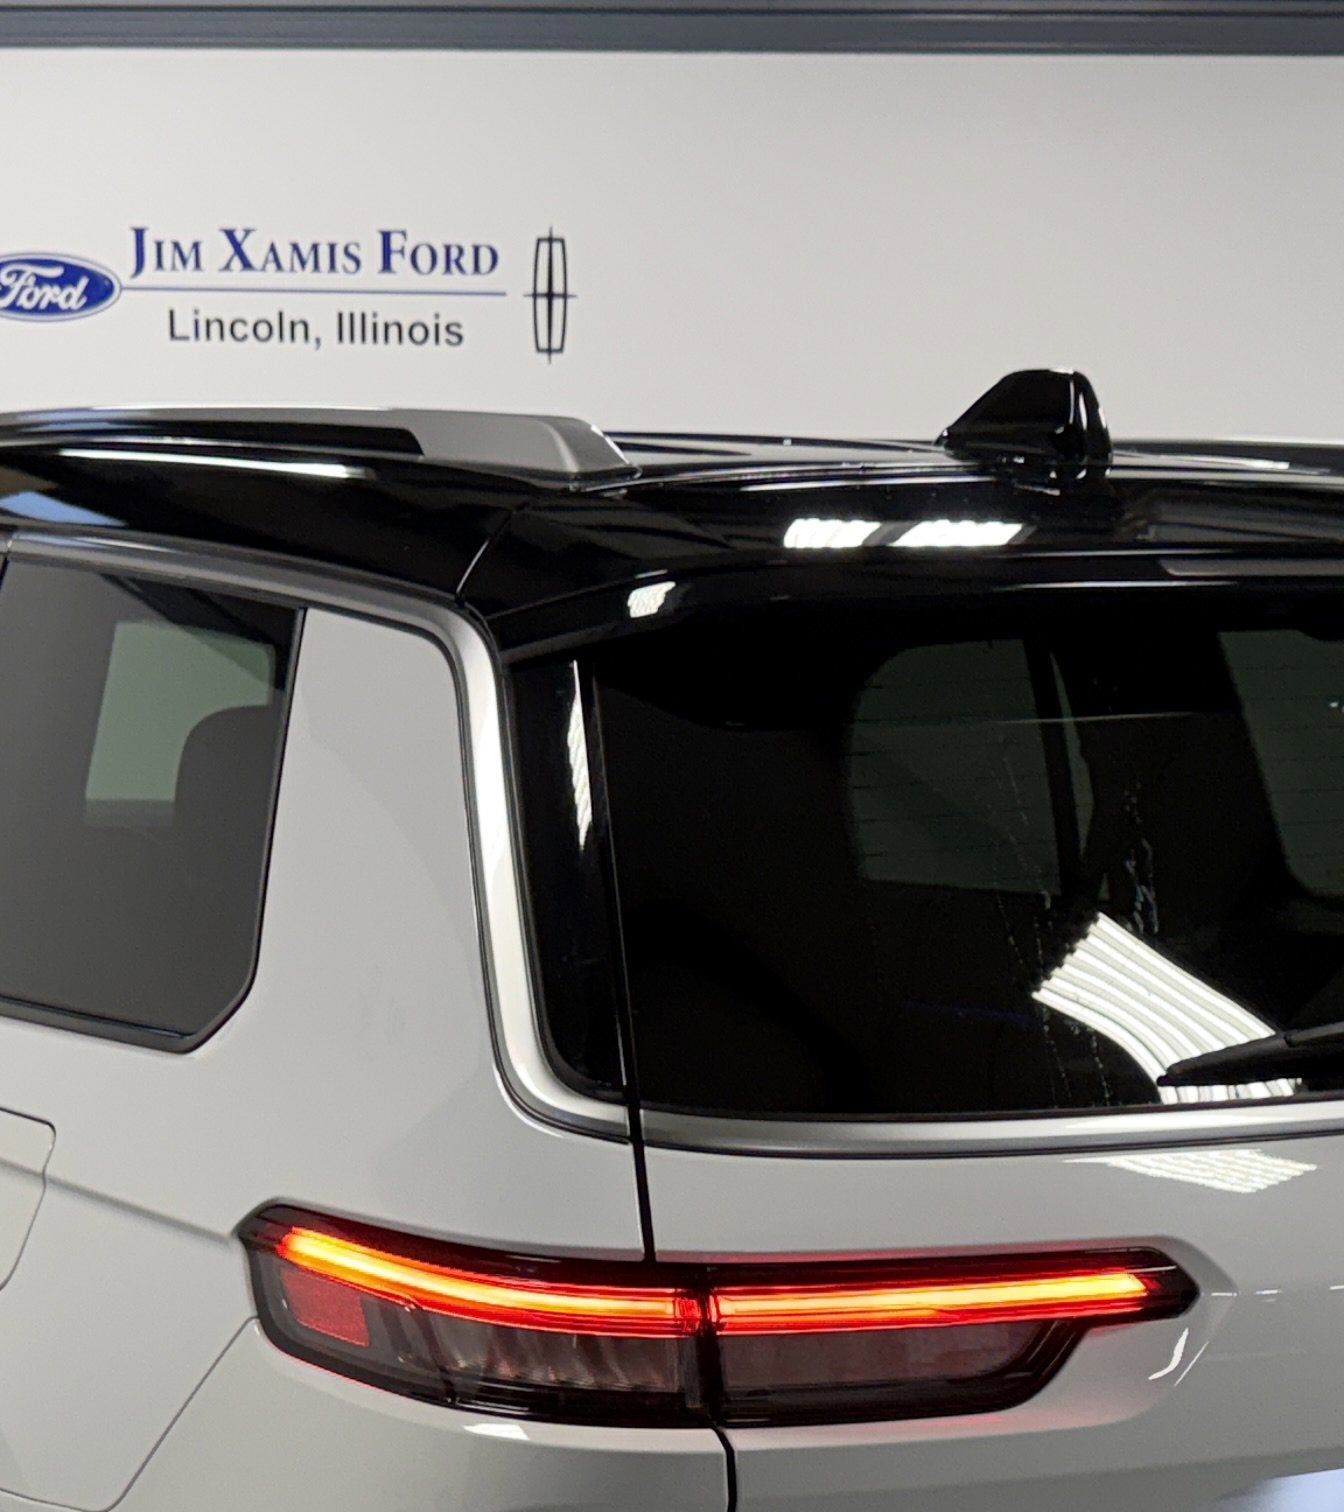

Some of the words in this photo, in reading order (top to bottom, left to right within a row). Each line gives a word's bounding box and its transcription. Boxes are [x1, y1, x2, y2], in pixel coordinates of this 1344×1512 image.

[129, 227, 203, 279] JIM
[218, 228, 362, 274] XAMIS
[376, 230, 500, 276] FORD
[167, 309, 322, 351] Lincoln,
[336, 311, 464, 347] Illinois
